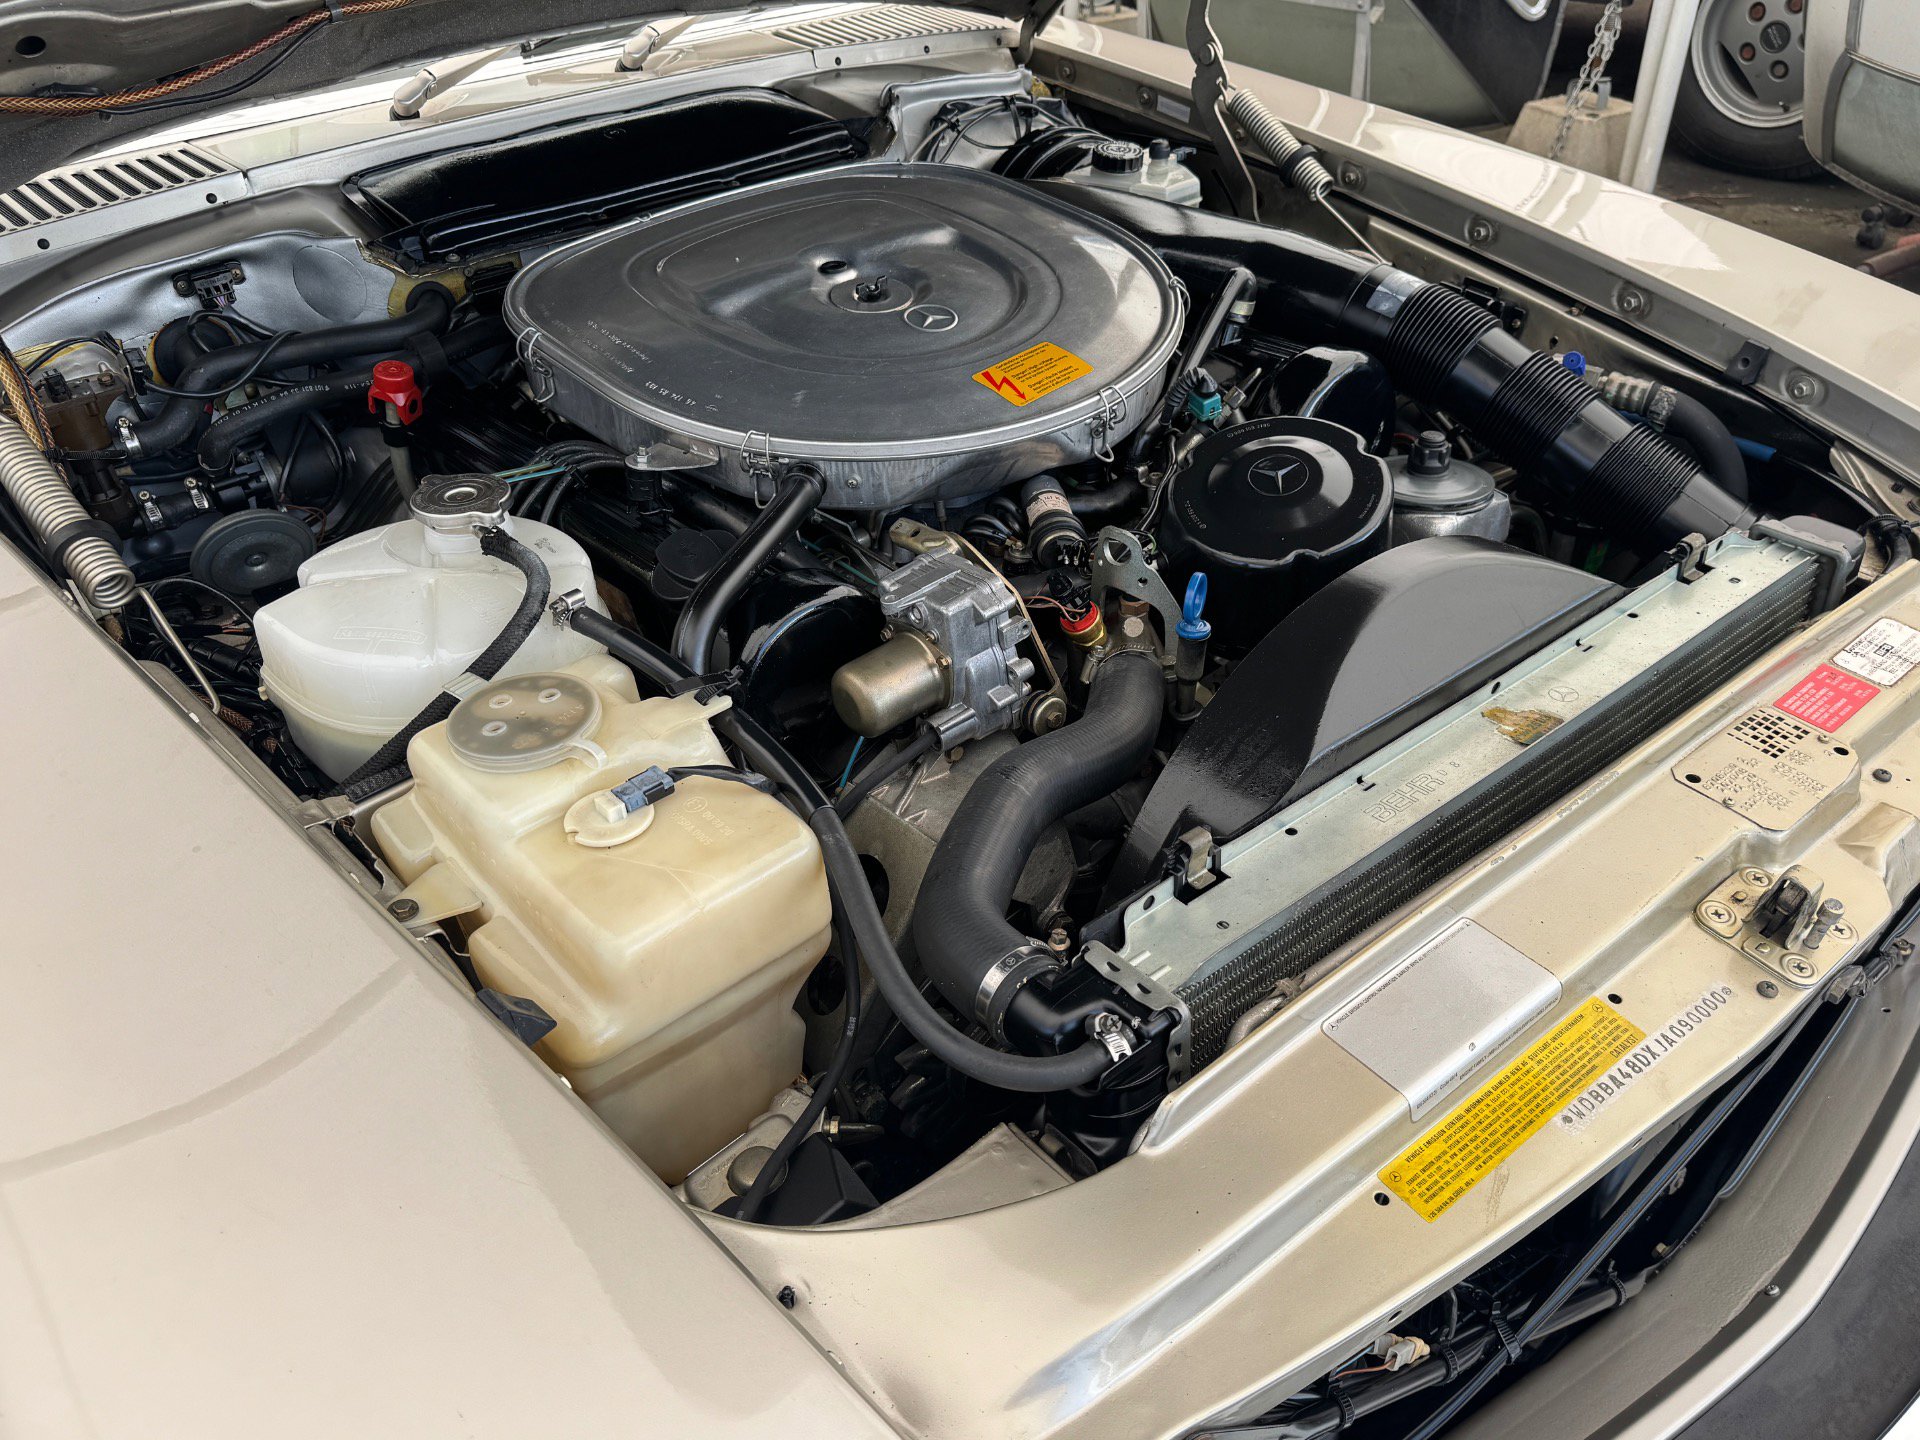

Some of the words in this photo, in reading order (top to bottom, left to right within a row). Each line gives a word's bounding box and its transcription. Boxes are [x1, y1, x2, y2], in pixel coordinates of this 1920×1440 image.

[1363, 772, 1446, 823] BEHR
[1608, 1032, 1639, 1059] CATALYST
[1403, 1145, 1425, 1164] VEHICLE
[1421, 1127, 1447, 1149] EMISSION
[1443, 1111, 1466, 1131] CONTROL
[1462, 1088, 1494, 1115] INFORMATION
